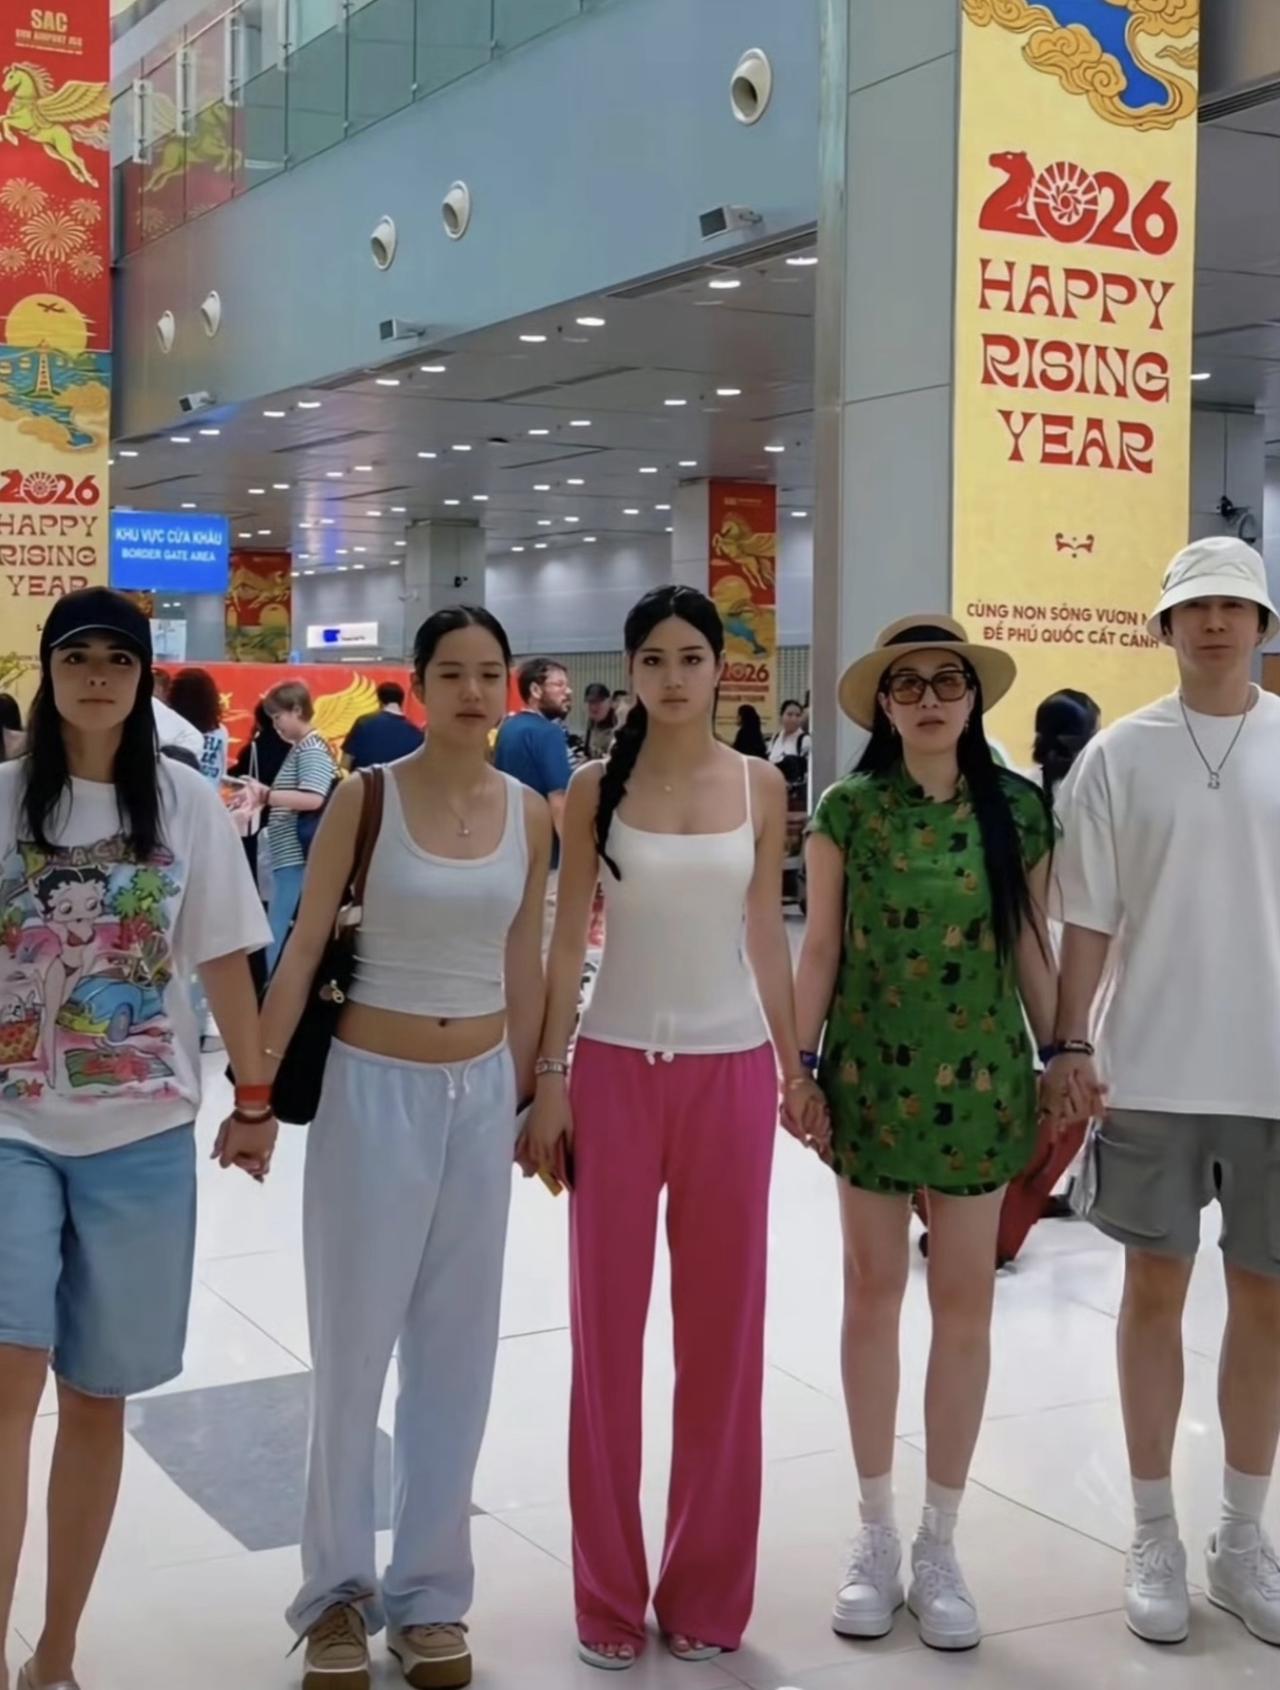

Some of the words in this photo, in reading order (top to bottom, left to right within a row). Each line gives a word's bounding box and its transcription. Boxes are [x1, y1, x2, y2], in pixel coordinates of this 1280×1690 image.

[31, 8, 68, 33] SAC
[978, 150, 1179, 256] 2026
[978, 257, 1175, 331] HAPPY
[980, 332, 1170, 403] RISING
[996, 408, 1155, 474] YEAR
[0, 469, 100, 507] 2026
[0, 513, 98, 538] HAPPY
[116, 528, 139, 542] KHU
[0, 544, 96, 567] RISING
[121, 547, 161, 560] BORDER
[163, 549, 187, 561] GATE
[190, 550, 216, 562] AREA
[967, 600, 1009, 619] CÙNG
[1013, 606, 1047, 621] NON
[1050, 602, 1092, 622] SÔNG
[1008, 623, 1038, 642] PHÚ
